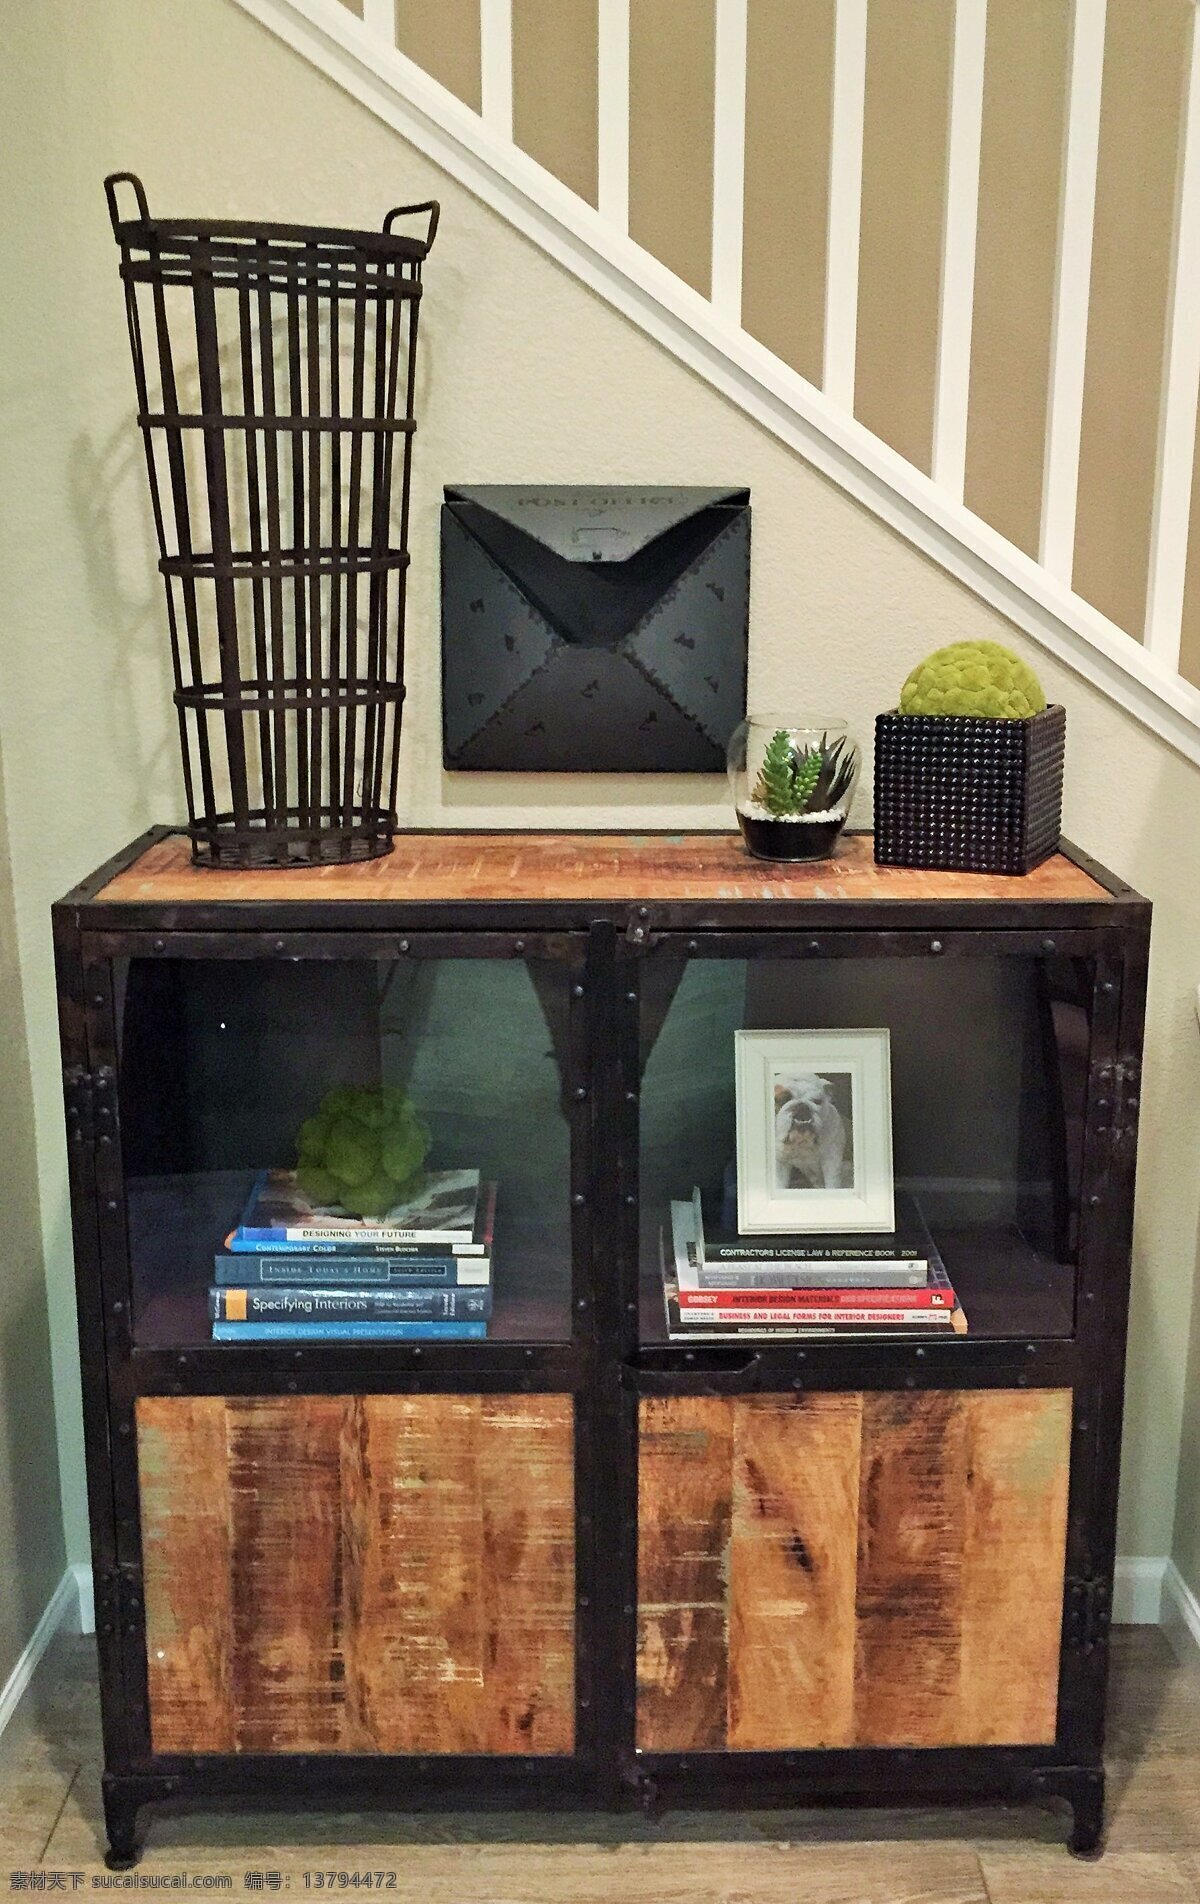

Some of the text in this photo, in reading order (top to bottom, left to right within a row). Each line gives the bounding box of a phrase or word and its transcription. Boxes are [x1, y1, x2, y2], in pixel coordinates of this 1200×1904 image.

[302, 1230, 352, 1238] DESIGNING
[381, 1231, 417, 1239] FUTURE
[719, 1249, 774, 1257] CONTRACTORS
[775, 1249, 806, 1257] LICENSE
[806, 1249, 824, 1257] LAW
[831, 1249, 873, 1257] REFERENCE
[874, 1249, 895, 1257] BOOK
[768, 1295, 796, 1304] DESIGN
[252, 1297, 368, 1312] Specifying Interiors
[719, 1312, 750, 1320] BUSINESS
[753, 1312, 768, 1320] AND
[770, 1312, 790, 1320] LEGAL
[793, 1312, 816, 1320] FORMS
[818, 1312, 832, 1320] FOR
[834, 1312, 865, 1320] INTERIOR
[867, 1312, 904, 1321] DESIGNERS
